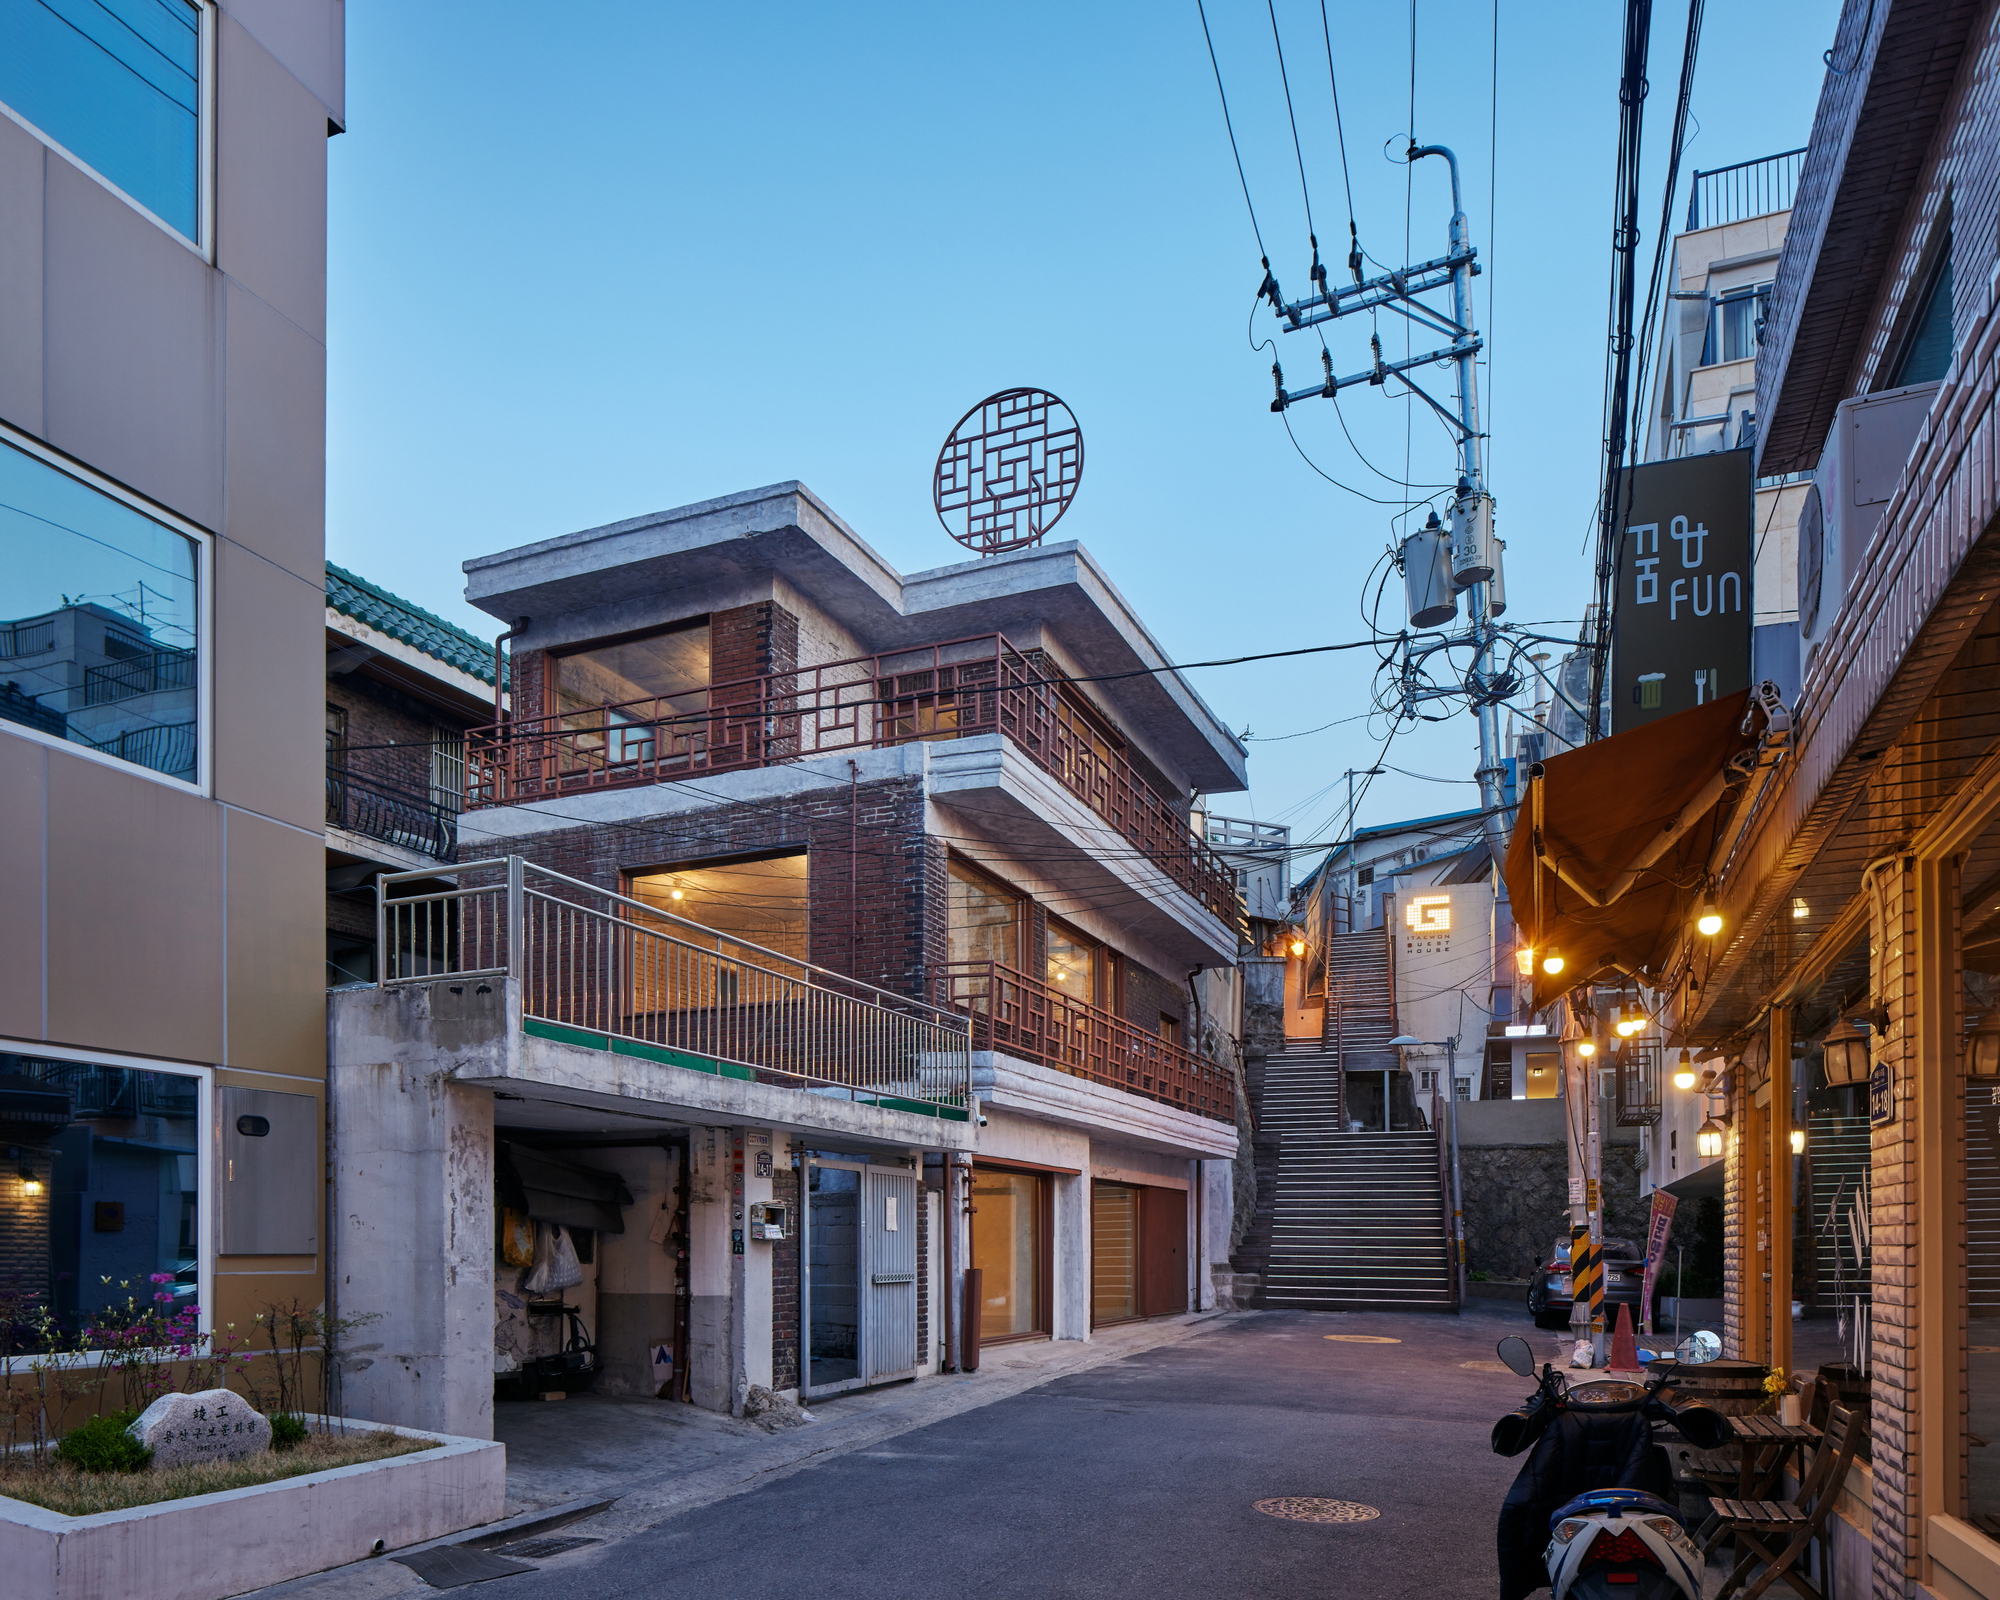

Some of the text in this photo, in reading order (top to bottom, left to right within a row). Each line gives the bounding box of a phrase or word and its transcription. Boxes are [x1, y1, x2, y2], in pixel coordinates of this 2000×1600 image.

[1463, 544, 1477, 556] 30
[1406, 895, 1451, 932] G
[1872, 1089, 1888, 1116] 14-18
[757, 1163, 772, 1175] 14-11
